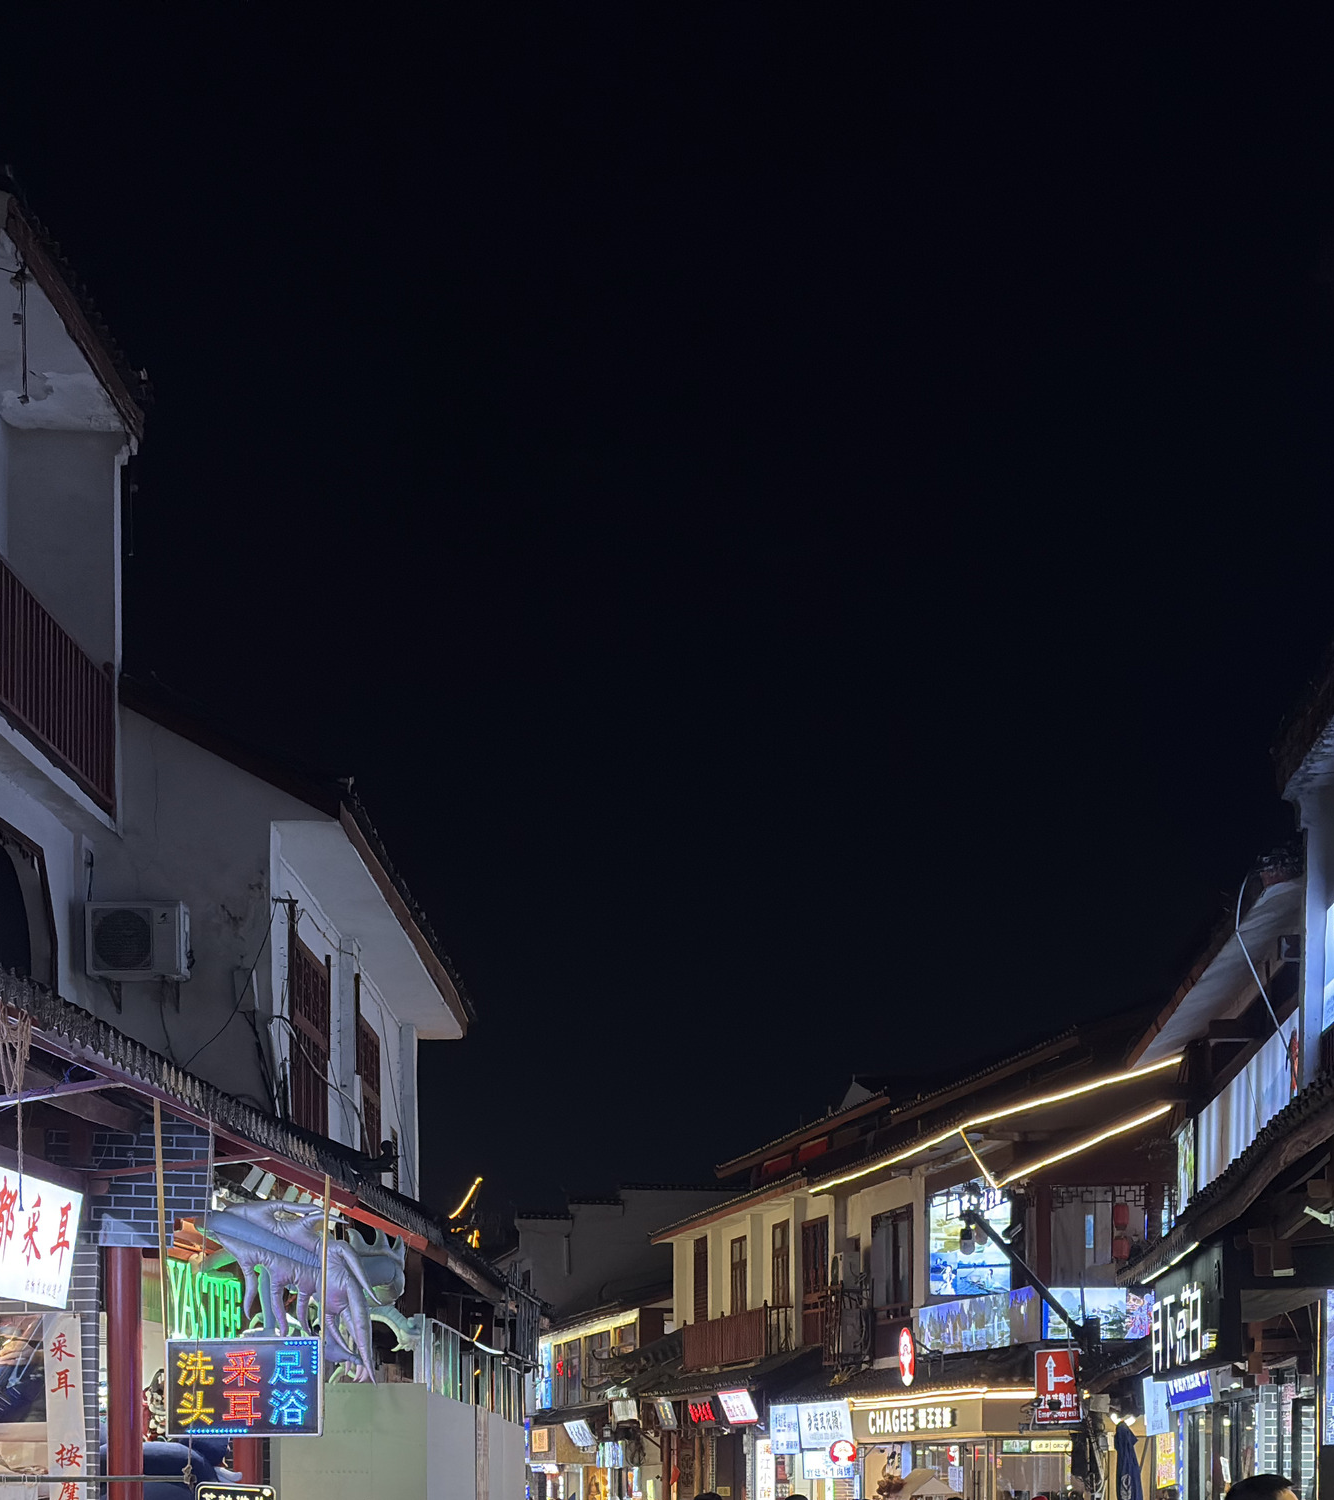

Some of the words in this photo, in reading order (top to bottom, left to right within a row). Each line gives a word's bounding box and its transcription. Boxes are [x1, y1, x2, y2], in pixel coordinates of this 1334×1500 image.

[49, 1331, 76, 1400] 采耳
[176, 1350, 215, 1426] 洗头
[221, 1350, 262, 1427] 采耳
[268, 1350, 309, 1426] 足浴
[868, 1407, 915, 1435] CHAGEE
